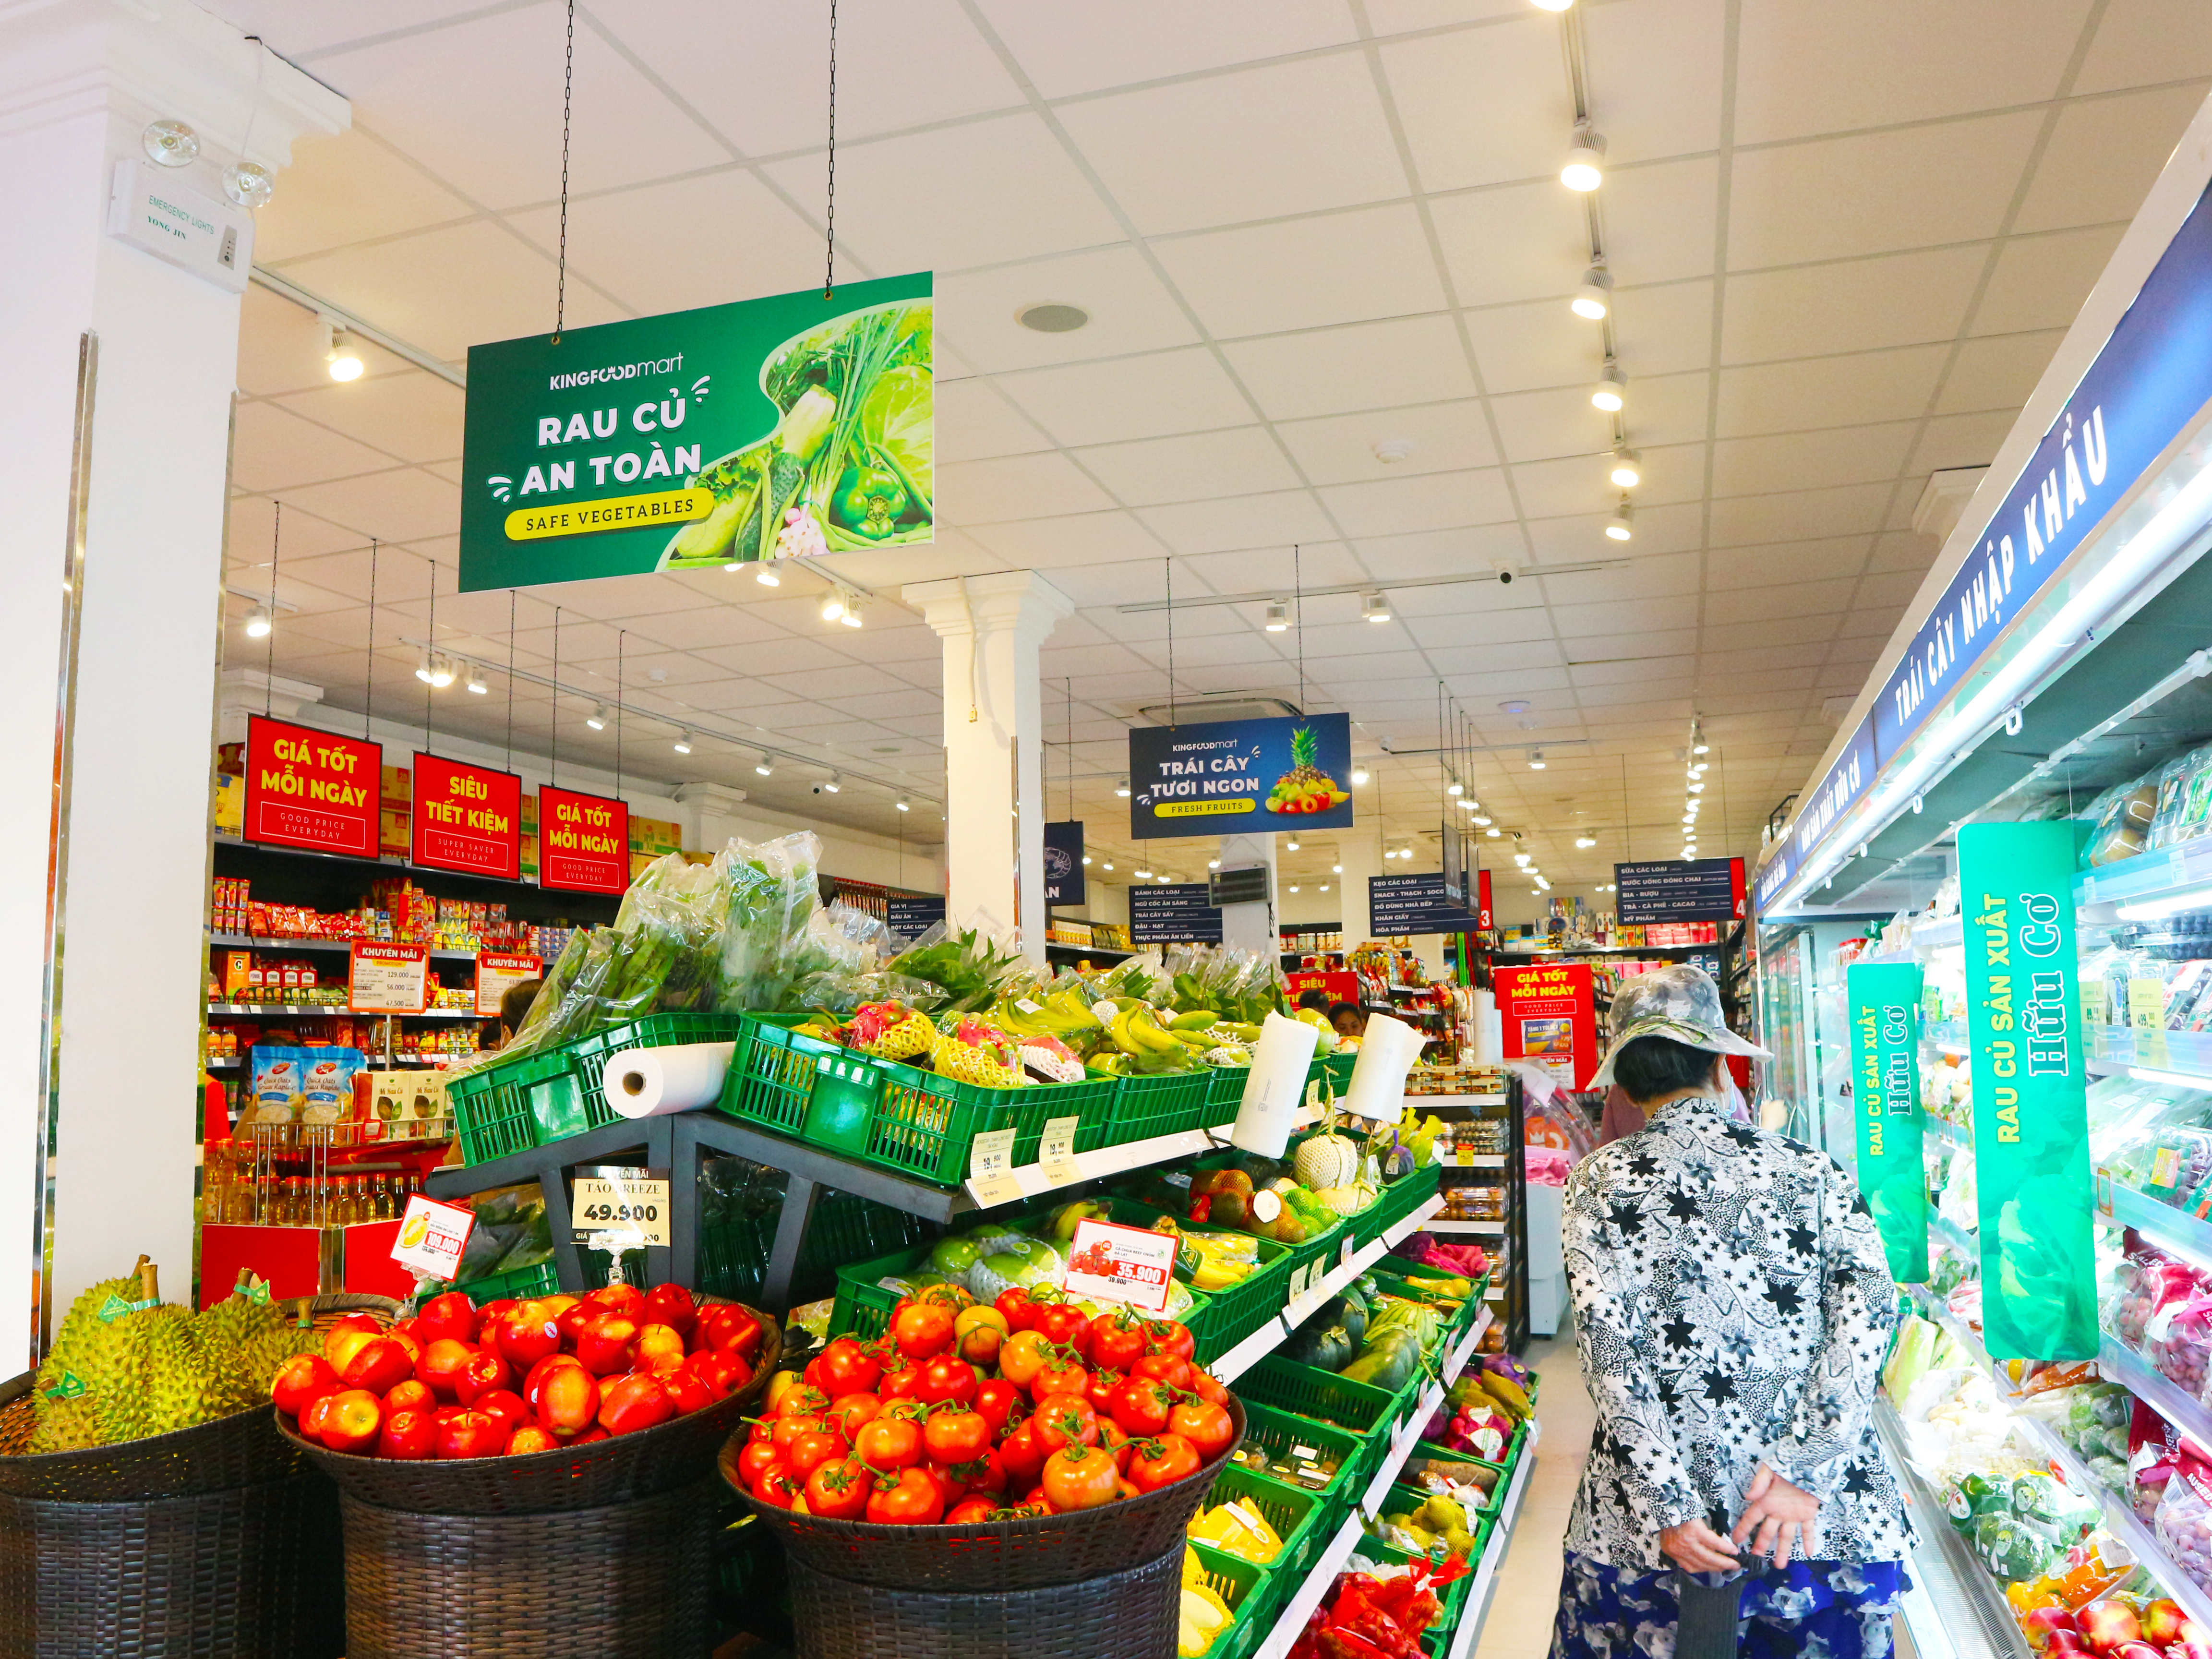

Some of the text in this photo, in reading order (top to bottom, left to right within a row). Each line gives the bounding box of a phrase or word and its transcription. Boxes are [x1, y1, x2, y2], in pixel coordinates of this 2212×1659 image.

[149, 195, 214, 235] EMERGENCY LIGHTS
[147, 216, 187, 240] YONG JIN
[550, 352, 684, 390] KINGFOODmart
[538, 387, 686, 446] RAU CỦ
[519, 441, 701, 496] AN TOÀN
[526, 499, 694, 531] SAFE VEGETABLES
[1895, 404, 2108, 726] TRÁI CÂY NHẬP KHẨU
[1172, 738, 1238, 752] KINGFOODmart
[274, 739, 358, 774] GIÁ TỐT
[1160, 755, 1250, 776] TRÁI CÂY
[261, 764, 367, 807] MỖI NGÀY
[449, 775, 488, 800] SIÊU
[1151, 778, 1259, 797] TƯƠI NGON
[426, 799, 508, 835] TIẾT KIỆM
[556, 803, 612, 828] GIÁ TỐT
[1172, 802, 1243, 814] FRESH FRUITS
[280, 813, 345, 830] GOOD PRICE
[285, 824, 340, 840] EVERYDAY
[438, 838, 494, 854] SUPER SAVER
[550, 824, 619, 854] MỖI NGÀY
[445, 849, 488, 862] EVERYDAY
[566, 873, 602, 882] EVERYDAY
[1736, 899, 1746, 916] 4
[1481, 910, 1490, 927] 3
[362, 947, 417, 959] KHUYẾN MÃI
[487, 958, 533, 969] KHUYẾN MÃI
[1299, 977, 1326, 988] SIÊU
[1517, 969, 1568, 983] GIÁ TỐT
[2019, 893, 2069, 1077] Hữu Cơ
[1511, 984, 1576, 998] MỖI NGÀY
[1974, 893, 2020, 1142] RAU CỦ SẢN XUẤT
[1883, 1005, 1912, 1116] Hữu Cơ
[1856, 1005, 1884, 1156] RAU CỦ SẢN XUẤT
[633, 1168, 649, 1179] MÃI
[586, 1180, 612, 1193] TÁO
[584, 1204, 657, 1222] 49.900
[427, 1231, 459, 1254] 109.000
[576, 1231, 588, 1239] GIÁ
[1117, 1262, 1161, 1284] 35.900
